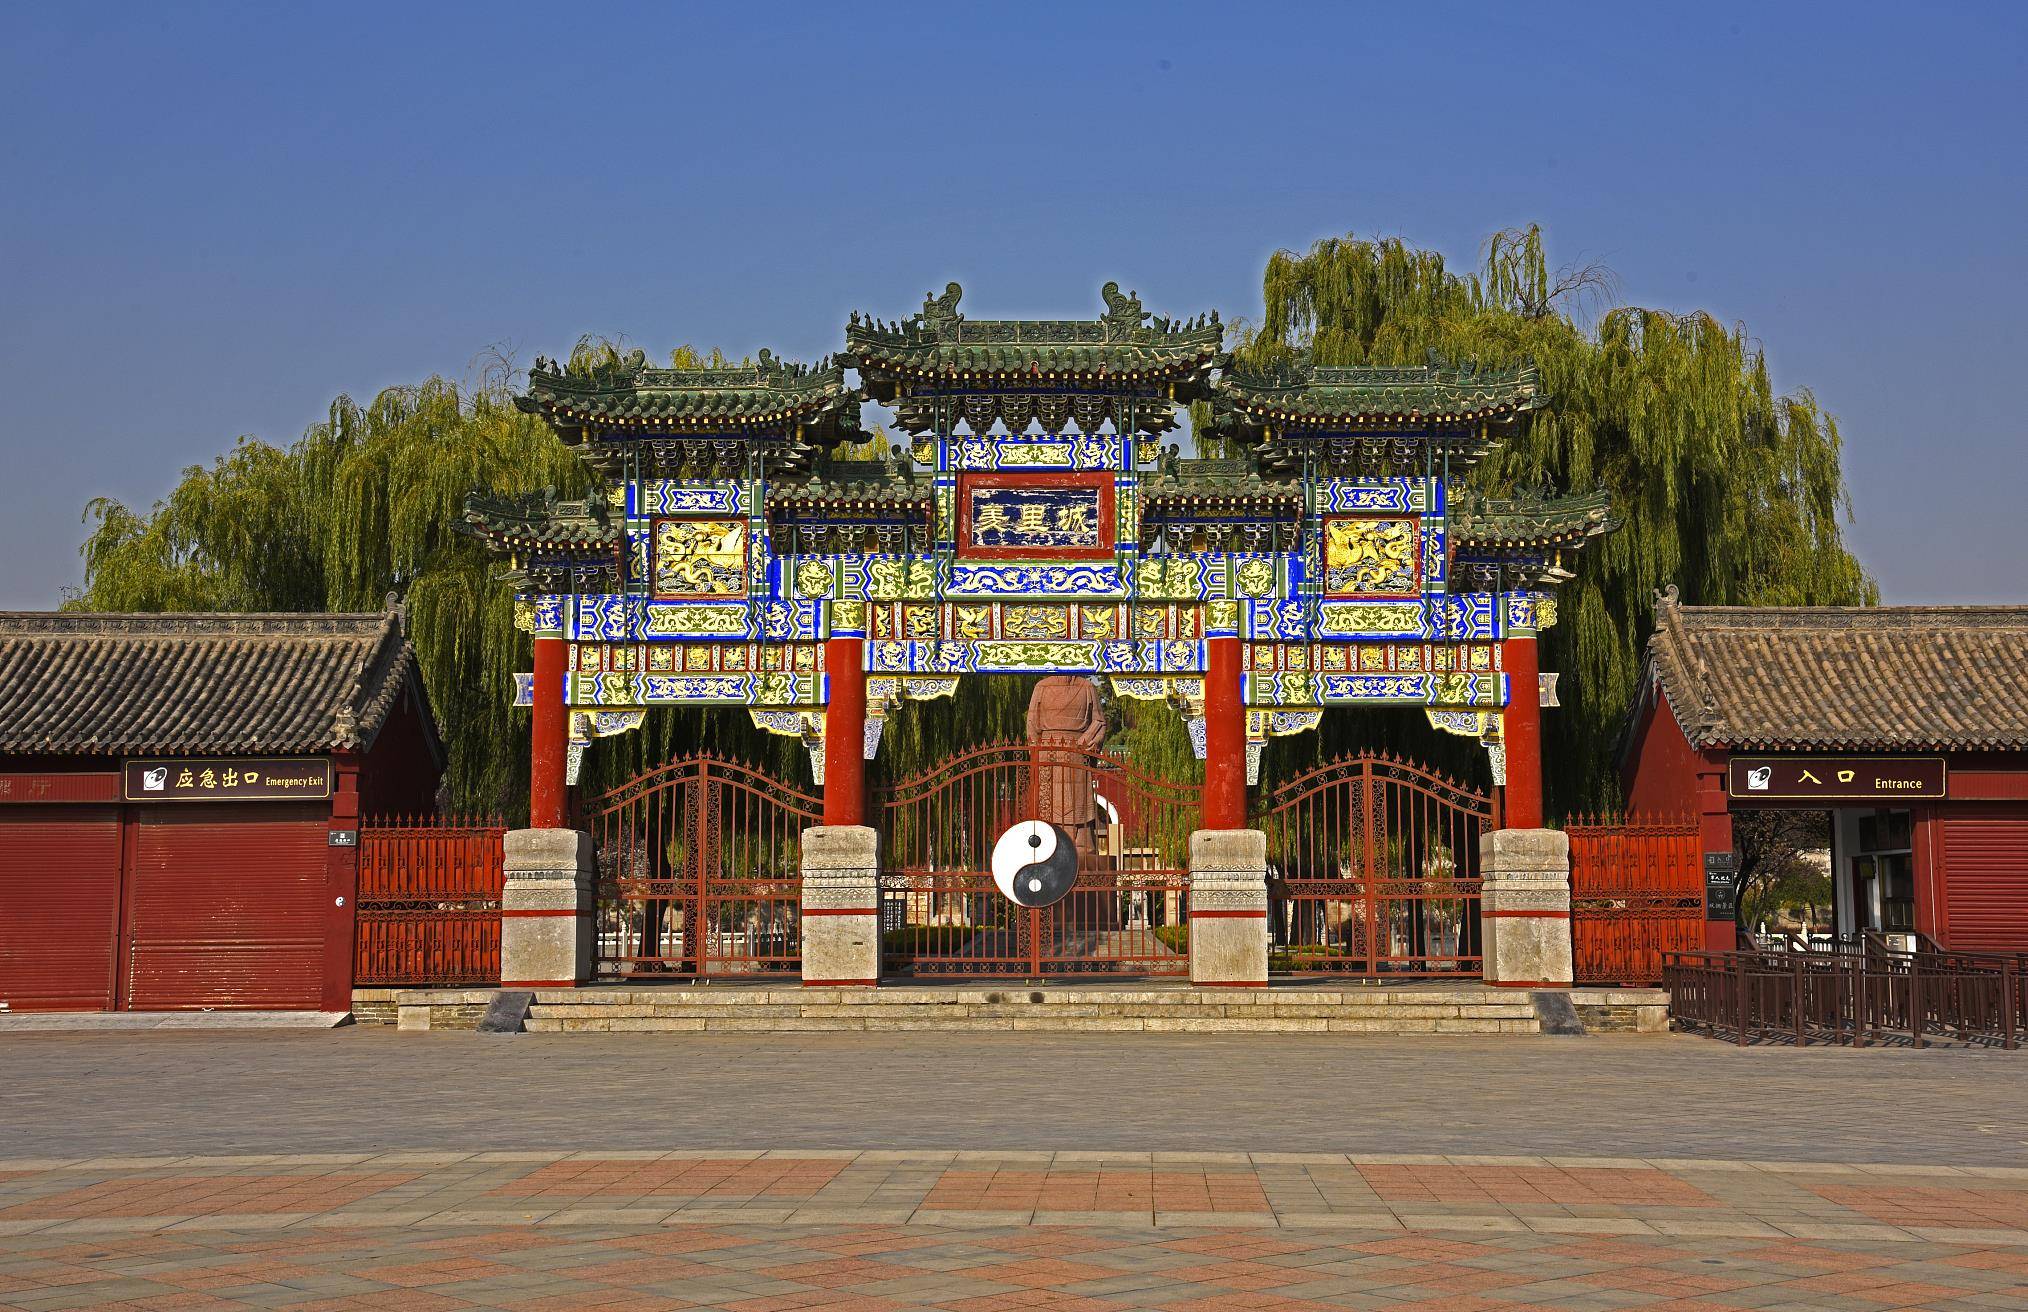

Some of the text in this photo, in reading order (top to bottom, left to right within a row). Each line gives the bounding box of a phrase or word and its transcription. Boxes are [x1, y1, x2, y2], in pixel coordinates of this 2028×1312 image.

[175, 767, 260, 789] 应急出口
[265, 777, 324, 788] Emergency Exit
[1797, 769, 1855, 785] 入口
[1875, 778, 1922, 789] Entrance
